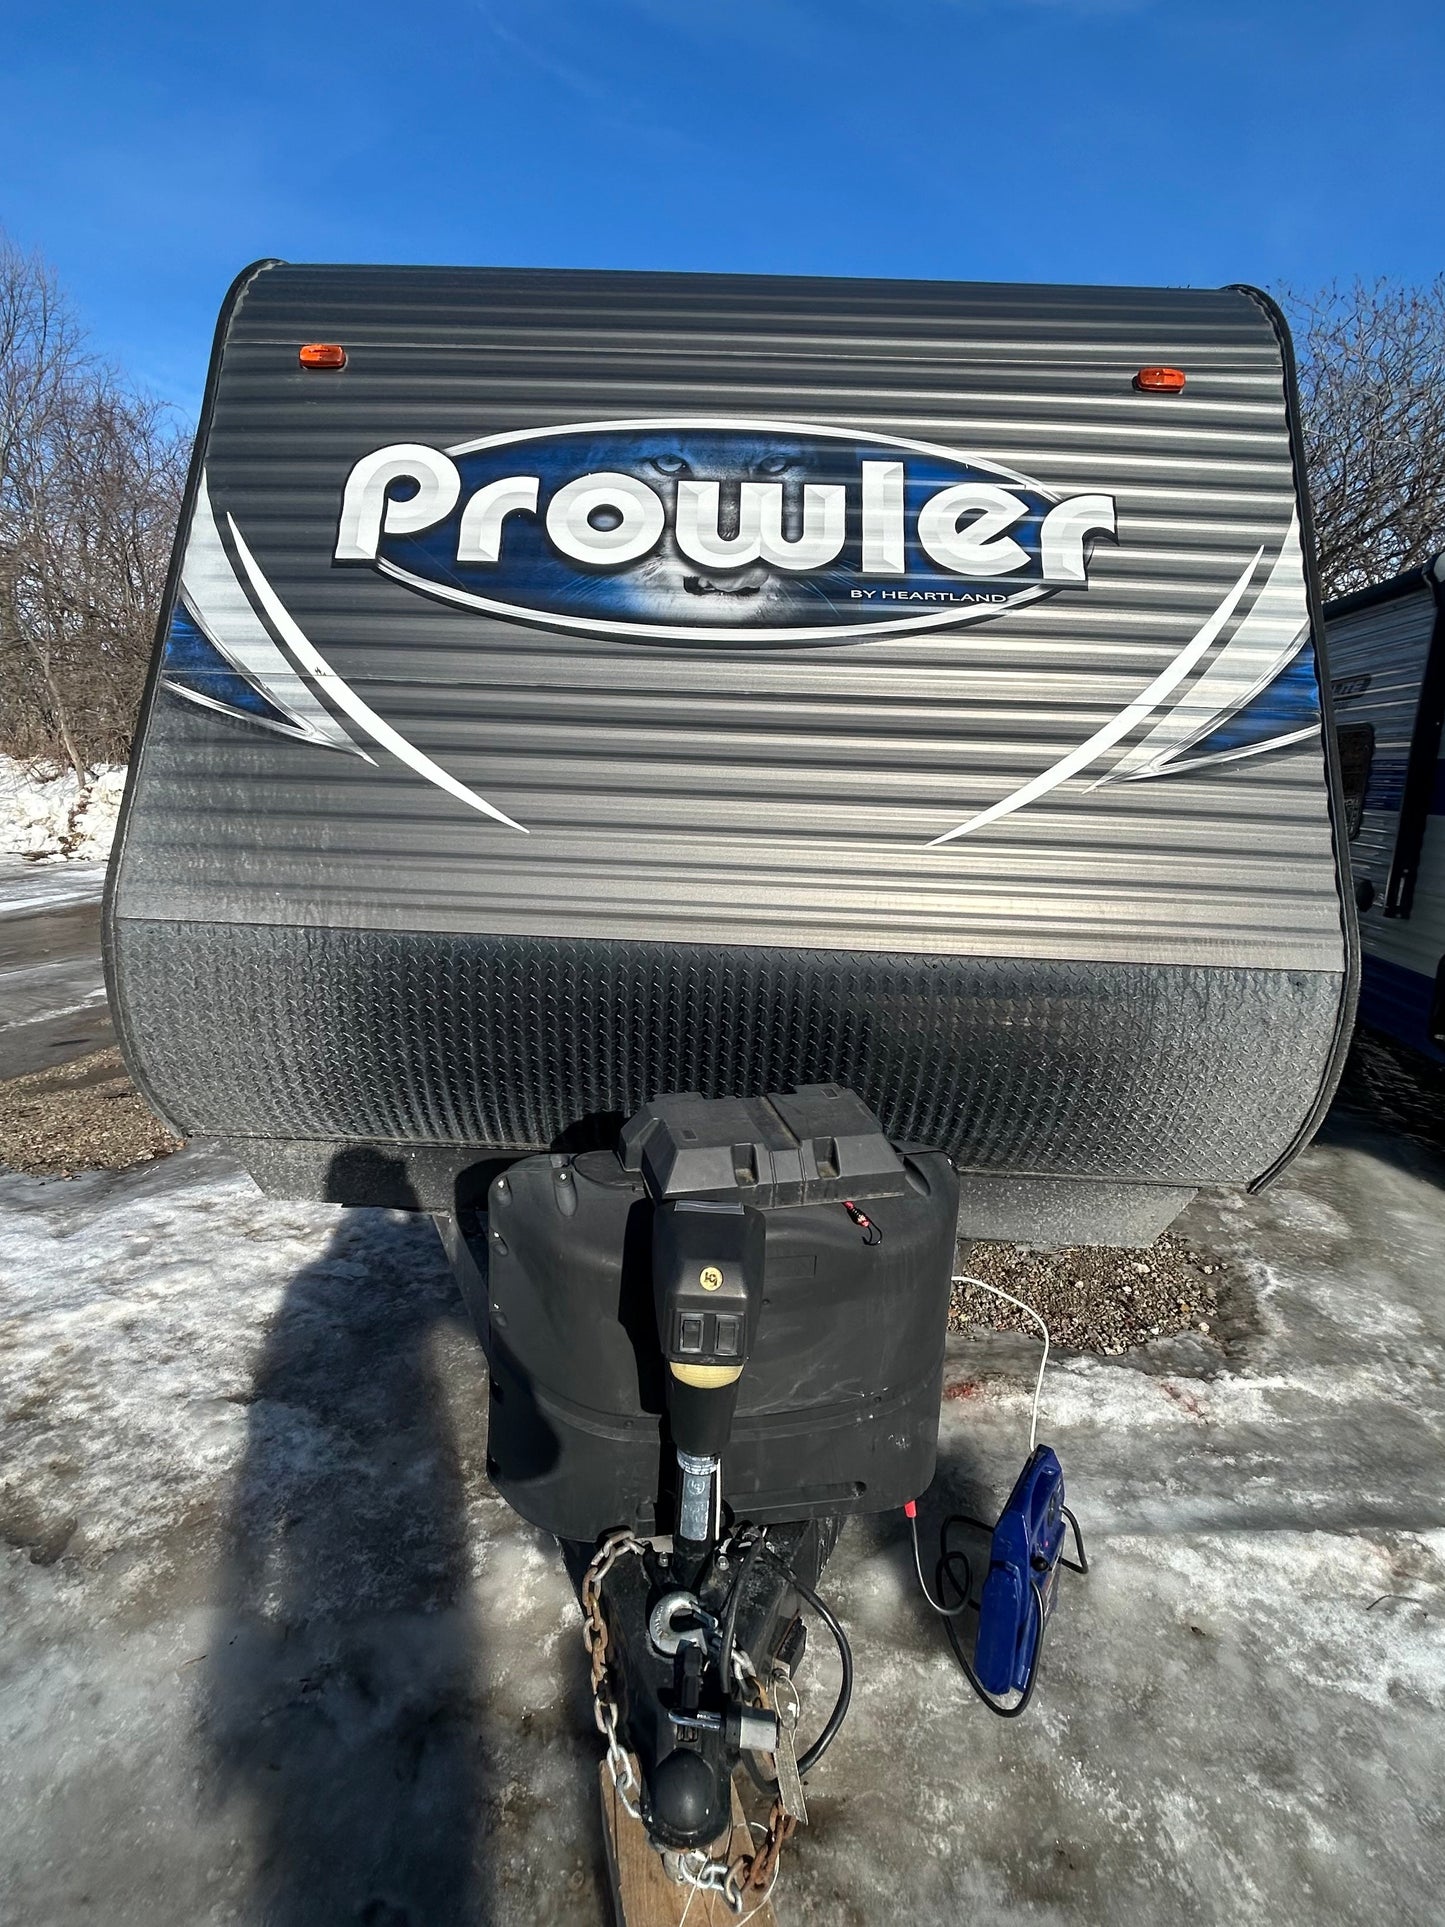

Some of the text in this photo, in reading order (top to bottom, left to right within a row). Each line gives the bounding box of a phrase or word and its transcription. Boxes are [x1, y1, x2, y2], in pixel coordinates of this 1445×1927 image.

[334, 443, 1116, 581] Prowler
[851, 589, 1007, 603] BY HEARTLAND
